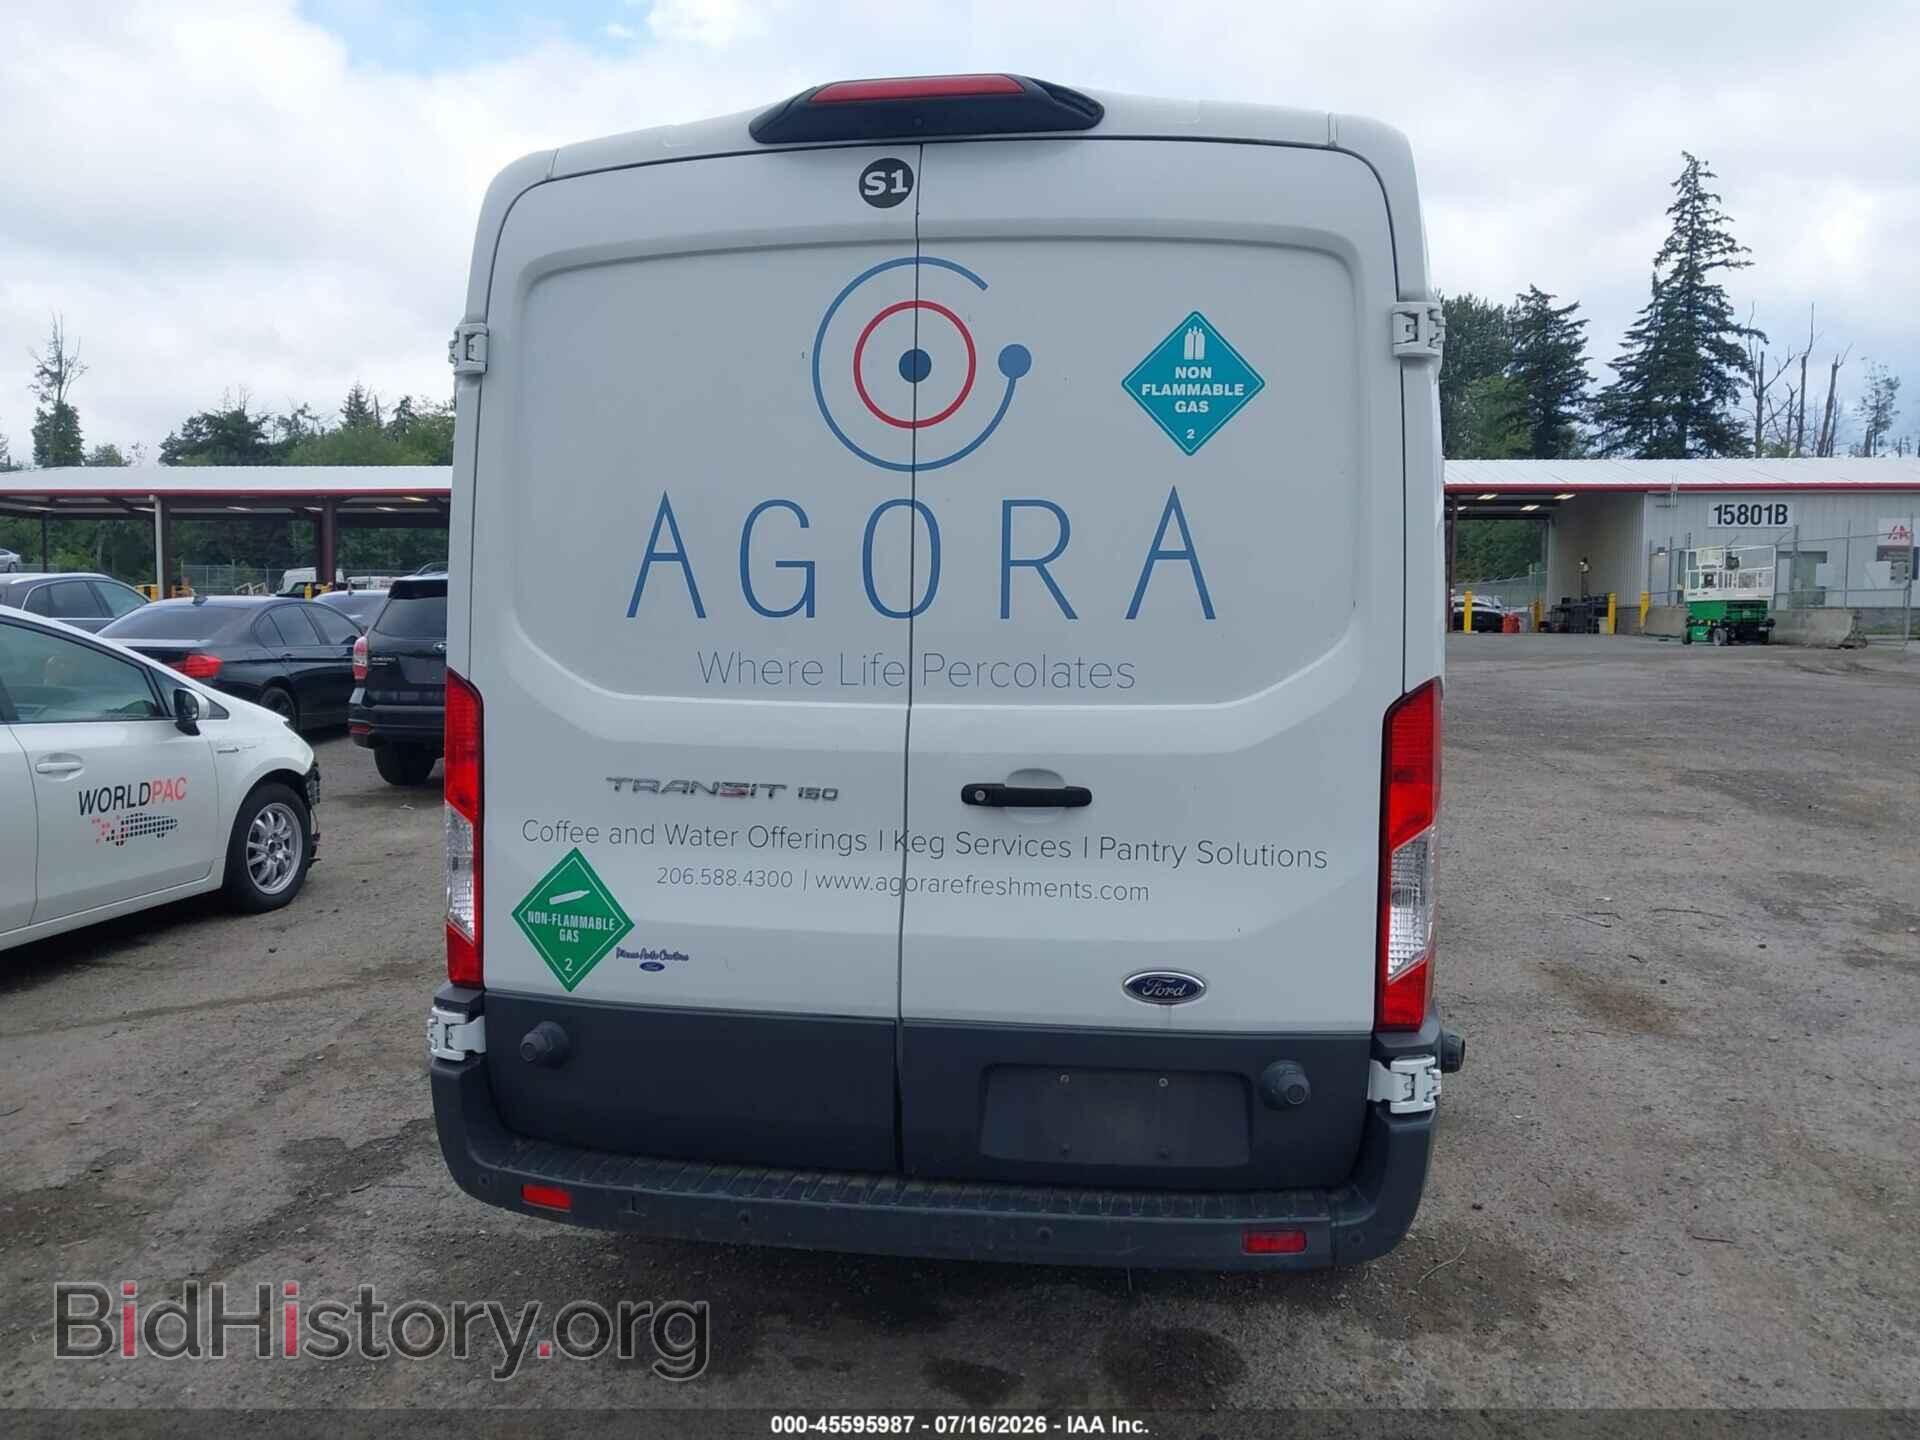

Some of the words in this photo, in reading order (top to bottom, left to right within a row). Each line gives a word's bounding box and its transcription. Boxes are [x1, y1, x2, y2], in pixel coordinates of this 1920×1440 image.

[864, 169, 908, 196] S1
[1175, 366, 1212, 379] NON
[1142, 383, 1245, 396] FLAMMABLE
[1174, 401, 1209, 413] GAS
[1185, 428, 1196, 439] 2
[1713, 503, 1788, 525] 15801B
[626, 486, 1216, 620] AGORA
[697, 651, 824, 686] Where
[841, 651, 905, 687] Life
[922, 652, 1136, 689] Percolates
[78, 776, 188, 817] WORLDPAC
[606, 777, 788, 799] TRANSIT
[798, 786, 839, 801] 150
[522, 819, 600, 845] Coffee
[608, 823, 655, 846] and
[664, 823, 738, 849] Water
[747, 824, 867, 857] Offerings
[894, 829, 945, 860] Keg
[955, 830, 1072, 859] Services
[1099, 836, 1188, 869] Pantry
[1196, 840, 1328, 870] Solutions
[656, 866, 793, 889] 206.588.4300
[815, 873, 1150, 902] www.agorarefreshments.com
[527, 911, 616, 931] NON-FLAMMABLE
[559, 929, 580, 943] GAS
[564, 958, 573, 971] 2
[1141, 977, 1187, 998] Ford
